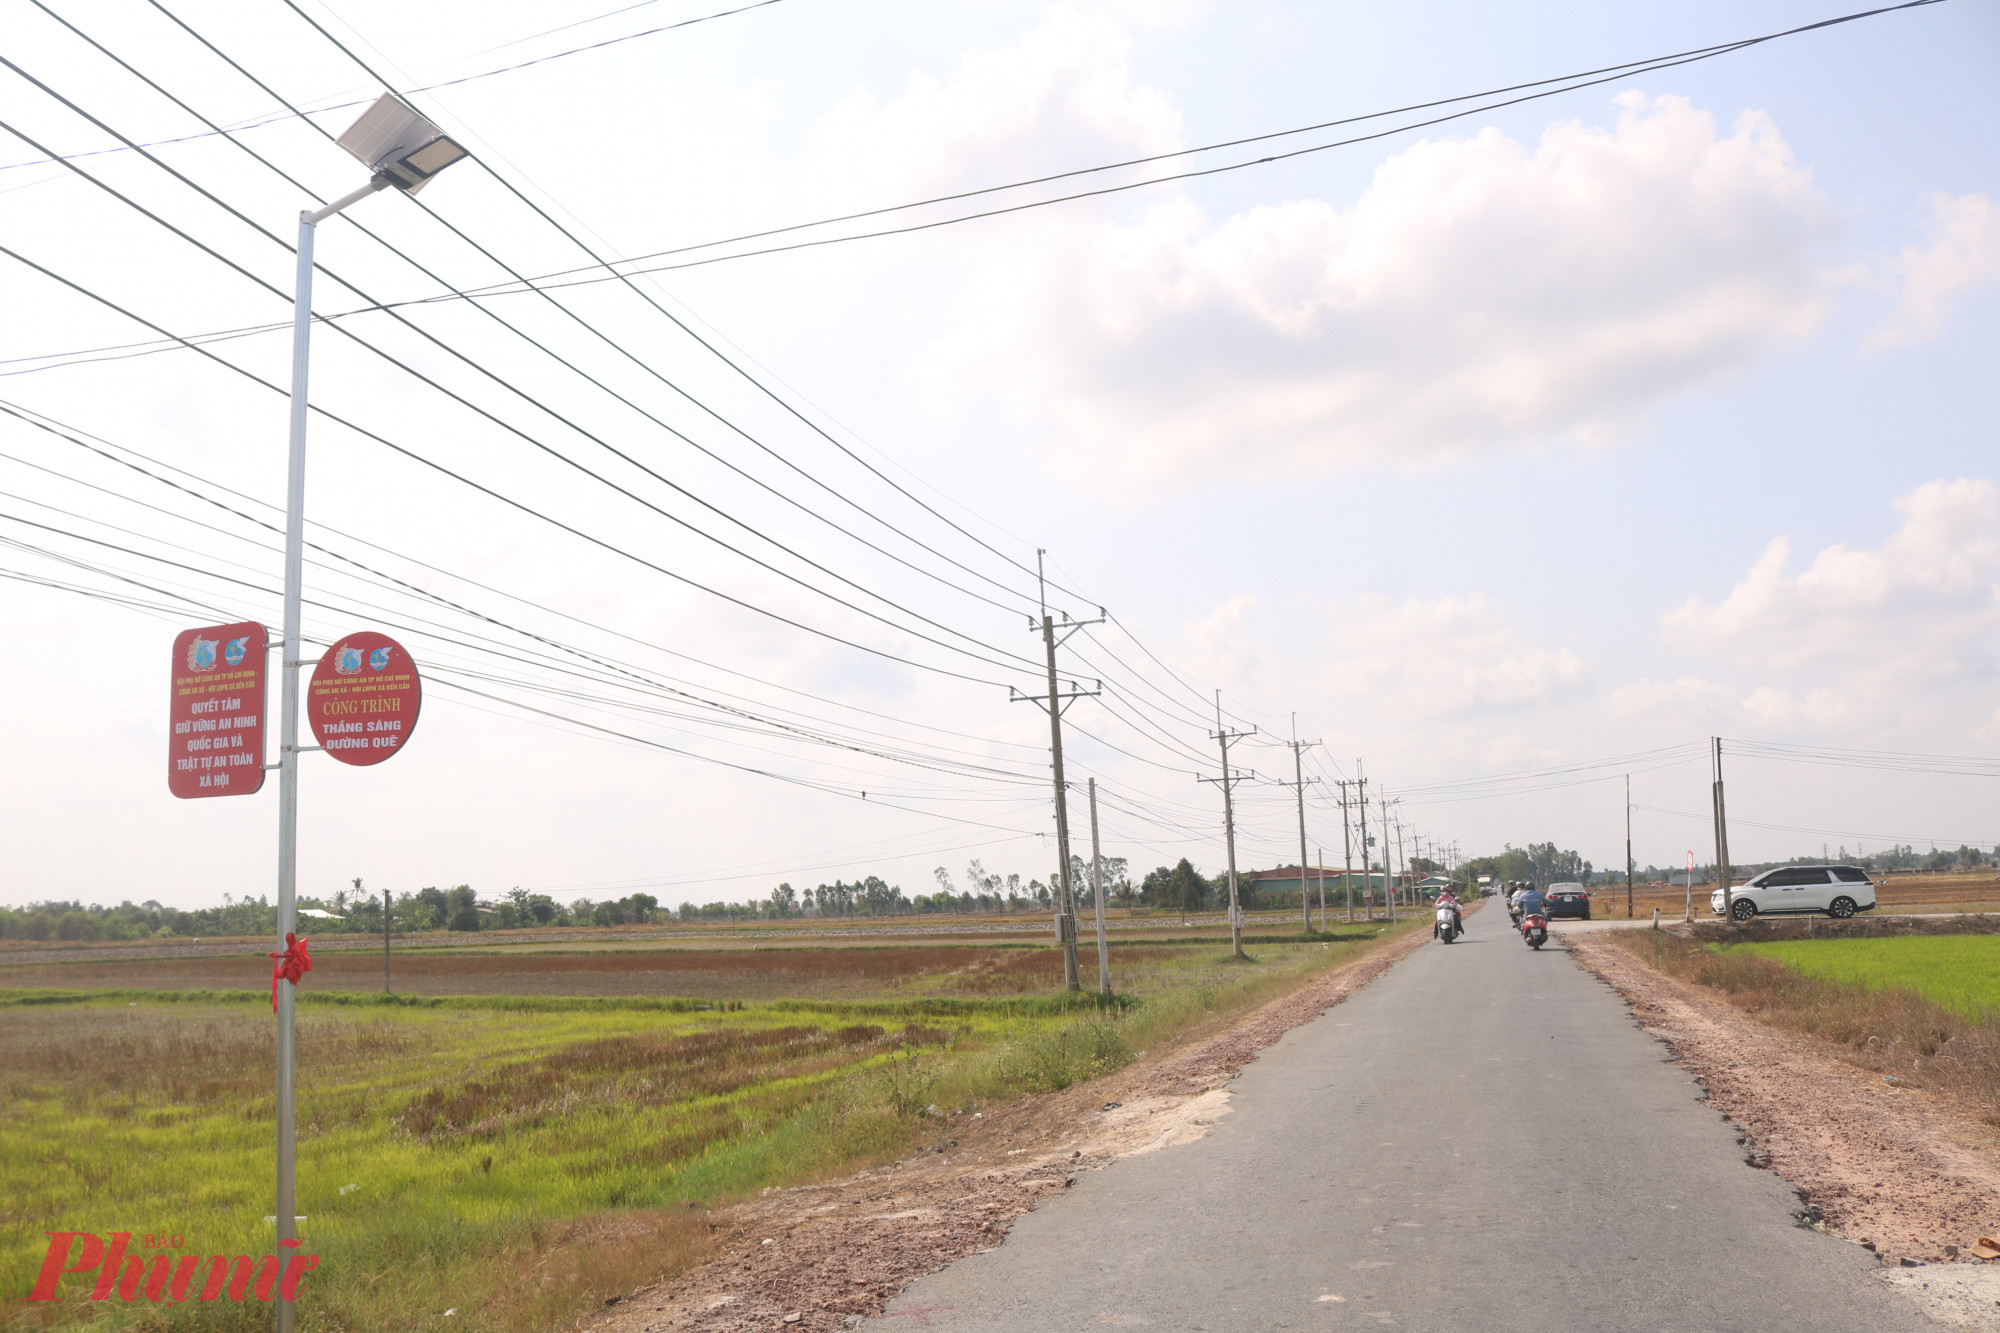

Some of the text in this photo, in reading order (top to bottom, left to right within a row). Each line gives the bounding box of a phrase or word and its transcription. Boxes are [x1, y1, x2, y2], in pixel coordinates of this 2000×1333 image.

[192, 697, 240, 715] QUYẾT TÂM
[324, 695, 400, 715] CÔNG TRÌNH
[176, 716, 256, 734] GIỮ VỮNG AN NINH
[367, 720, 401, 731] SÁNG
[188, 733, 243, 752] QUỐC GIA VÀ
[327, 735, 398, 749] ĐƯỜNG QUÊ
[177, 752, 253, 771] TRẬT TỰ AN TOÀN
[200, 772, 229, 788] XÃ HỘI
